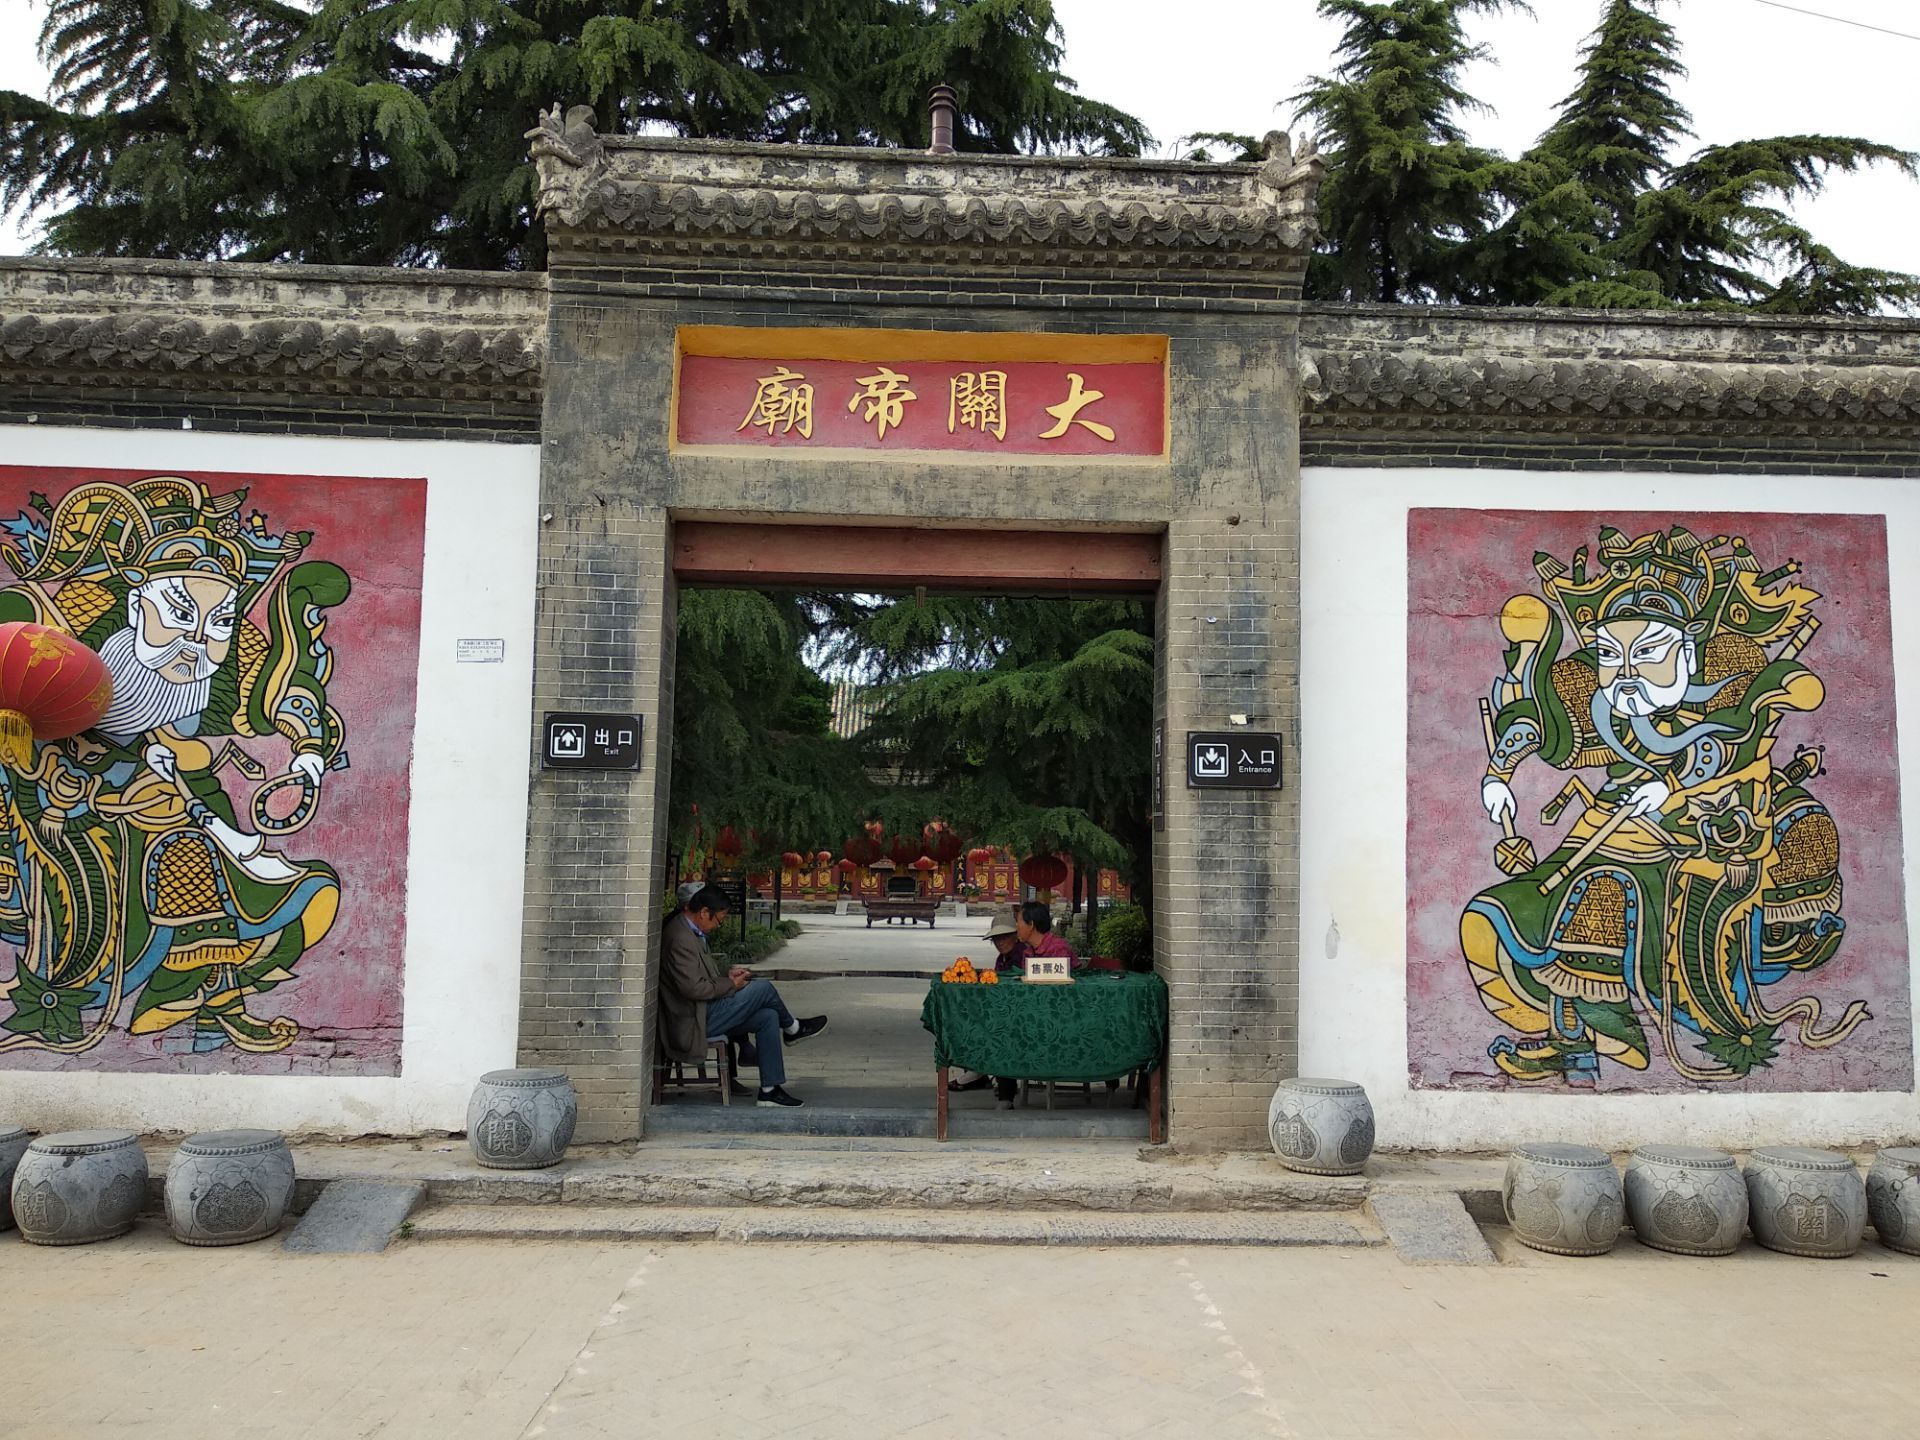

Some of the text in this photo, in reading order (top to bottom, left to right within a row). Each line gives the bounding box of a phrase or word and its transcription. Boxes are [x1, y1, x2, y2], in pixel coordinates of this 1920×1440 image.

[594, 728, 632, 746] 出口
[604, 747, 619, 755] Exit
[1237, 749, 1275, 765] 入口
[1031, 963, 1064, 975] 售票处
